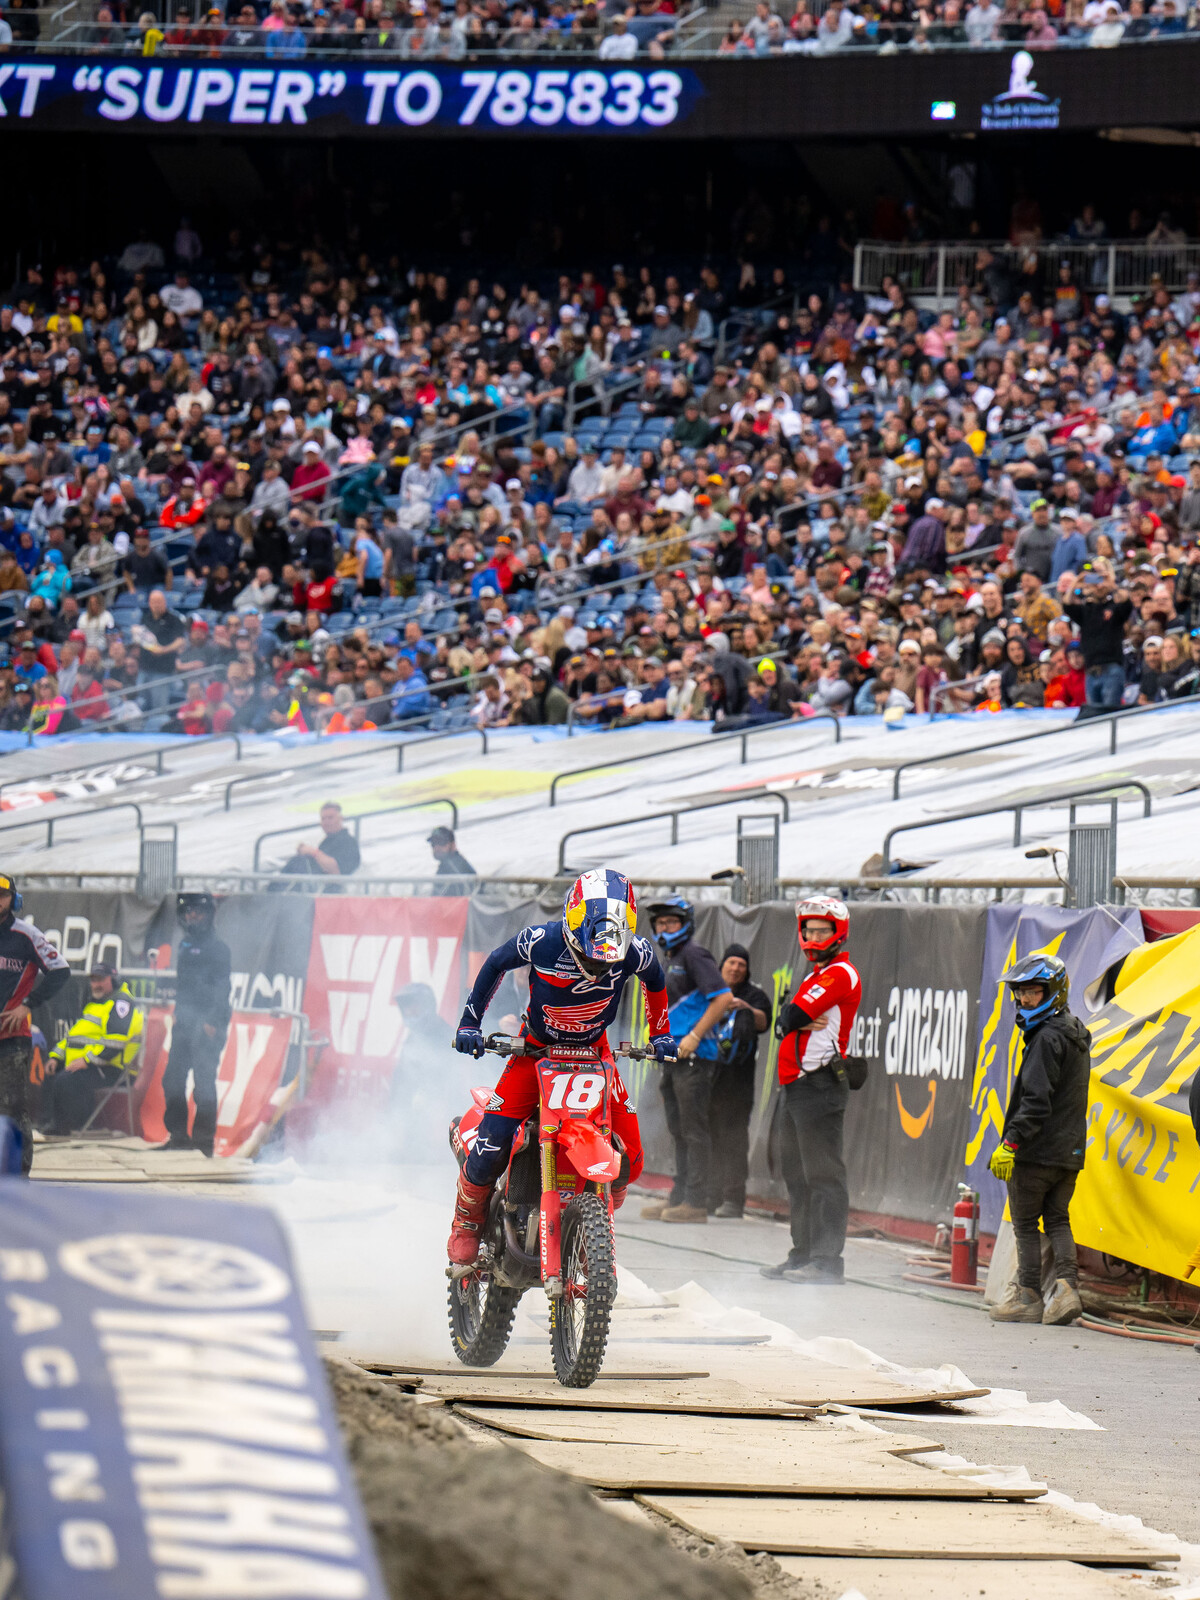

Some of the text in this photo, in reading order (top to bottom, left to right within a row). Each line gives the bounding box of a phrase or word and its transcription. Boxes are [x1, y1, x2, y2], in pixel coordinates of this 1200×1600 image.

[362, 71, 443, 126] TO
[459, 71, 682, 126] 785833
[865, 1007, 881, 1058] at
[884, 986, 968, 1080] amazon
[547, 1073, 606, 1110] 18
[540, 1210, 548, 1265] DUNLOP
[0, 1248, 118, 1570] RACING
[92, 1308, 371, 1599] YAMAHA
